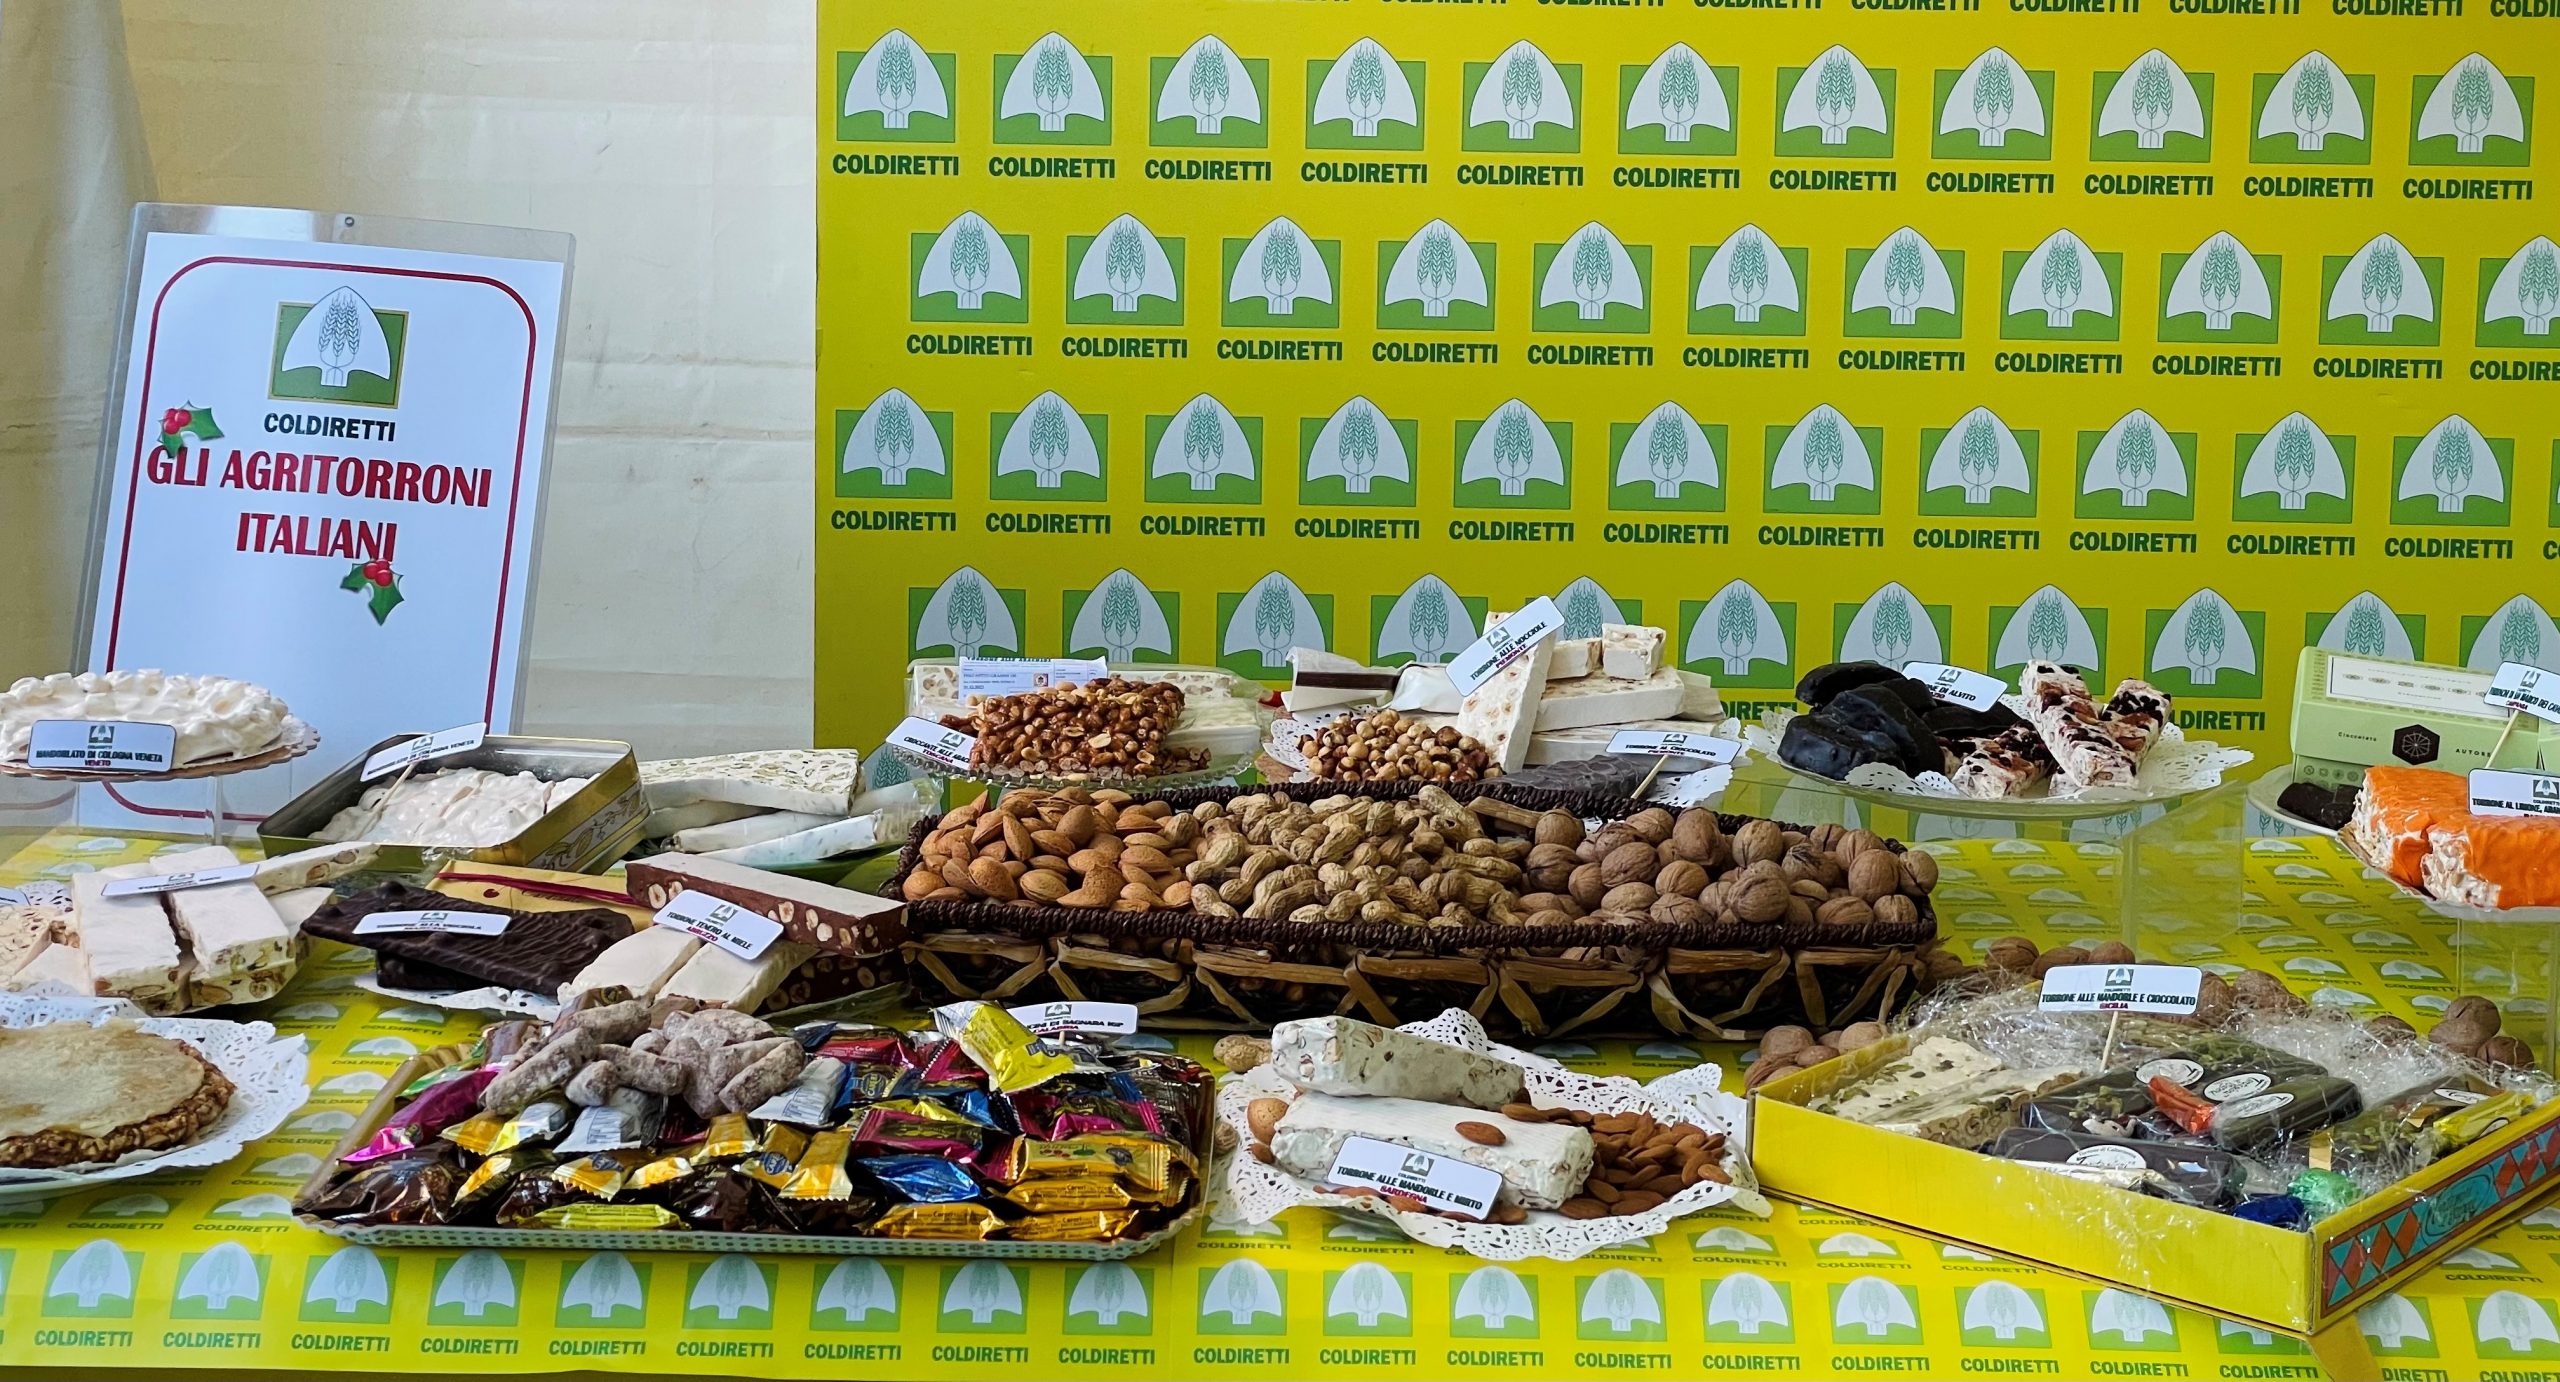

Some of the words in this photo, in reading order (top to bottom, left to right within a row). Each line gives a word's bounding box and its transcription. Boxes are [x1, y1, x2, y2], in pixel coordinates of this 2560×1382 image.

[2333, 0, 2462, 16] COLDIRETTI
[833, 154, 958, 175] COLDIRETTI
[989, 157, 1115, 178] COLDIRETTI
[1145, 160, 1271, 181] COLDIRETTI
[1301, 162, 1427, 183] COLDIRETTI
[1457, 165, 1583, 186] COLDIRETTI
[1614, 167, 1739, 188] COLDIRETTI
[1770, 170, 1896, 191] COLDIRETTI
[1927, 172, 2054, 193] COLDIRETTI
[2085, 175, 2213, 195] COLDIRETTI
[2244, 177, 2373, 197] COLDIRETTI
[2403, 179, 2532, 200] COLDIRETTI
[907, 335, 1032, 355] COLDIRETTI
[1062, 337, 1187, 358] COLDIRETTI
[1217, 340, 1342, 360] COLDIRETTI
[1373, 342, 1497, 363] COLDIRETTI
[1528, 345, 1653, 366] COLDIRETTI
[1683, 347, 1808, 368] COLDIRETTI
[1839, 350, 1964, 371] COLDIRETTI
[1995, 353, 2122, 373] COLDIRETTI
[2153, 355, 2281, 376] COLDIRETTI
[2314, 358, 2442, 379] COLDIRETTI
[264, 413, 396, 442] COLDIRETTI
[147, 448, 208, 488] GLI
[220, 449, 492, 507] AGRITORRONI
[831, 510, 956, 531] COLDIRETTI
[986, 513, 1111, 534] COLDIRETTI
[1140, 516, 1265, 536] COLDIRETTI
[1295, 518, 1419, 539] COLDIRETTI
[236, 512, 398, 562] ITALIANI
[1449, 521, 1574, 541] COLDIRETTI
[1604, 523, 1728, 544] COLDIRETTI
[1758, 526, 1883, 547] COLDIRETTI
[1914, 529, 2039, 549] COLDIRETTI
[2070, 532, 2196, 553] COLDIRETTI
[2227, 535, 2355, 556] COLDIRETTI
[2385, 538, 2513, 559] COLDIRETTI
[1514, 621, 1547, 646] NOCCIOLE
[1949, 689, 1977, 701] ALVITO
[2042, 993, 2076, 1003] TORRONE
[2077, 993, 2095, 1003] ALLE
[2097, 992, 2138, 1002] MANDORLE
[2139, 994, 2145, 1003] E
[2147, 994, 2195, 1005] CIOCCOLATO
[1337, 1166, 1377, 1181] TORRONE
[1377, 1174, 1397, 1186] ALLE
[1398, 1179, 1446, 1199] MANDORLE
[1446, 1192, 1453, 1201] E
[1380, 1186, 1428, 1204] SARDEGNA
[67, 1222, 164, 1231] COLDIRETTI
[193, 1223, 290, 1233] COLDIRETTI
[1197, 1242, 1292, 1250] COLDIRETTI
[1321, 1246, 1415, 1254] COLDIRETTI
[1693, 1256, 1787, 1267] COLDIRETTI
[1816, 1262, 1912, 1270] COLDIRETTI
[2445, 1274, 2543, 1284] COLDIRETTI
[34, 1330, 133, 1348] COLDIRETTI
[162, 1332, 261, 1350] COLDIRETTI
[291, 1334, 390, 1352] COLDIRETTI
[421, 1337, 519, 1354] COLDIRETTI
[549, 1339, 646, 1356] COLDIRETTI
[676, 1341, 774, 1358] COLDIRETTI
[804, 1343, 902, 1360] COLDIRETTI
[932, 1345, 1029, 1362] COLDIRETTI
[1059, 1346, 1155, 1364] COLDIRETTI
[1194, 1348, 1290, 1364] COLDIRETTI
[1320, 1349, 1416, 1365] COLDIRETTI
[1447, 1350, 1543, 1366] COLDIRETTI
[1575, 1353, 1672, 1369] COLDIRETTI
[1703, 1355, 1800, 1371] COLDIRETTI
[1832, 1357, 1930, 1373] COLDIRETTI
[1961, 1358, 2059, 1375] COLDIRETTI
[2090, 1361, 2189, 1378] COLDIRETTI
[2219, 1364, 2319, 1379] COLDIRETTI
